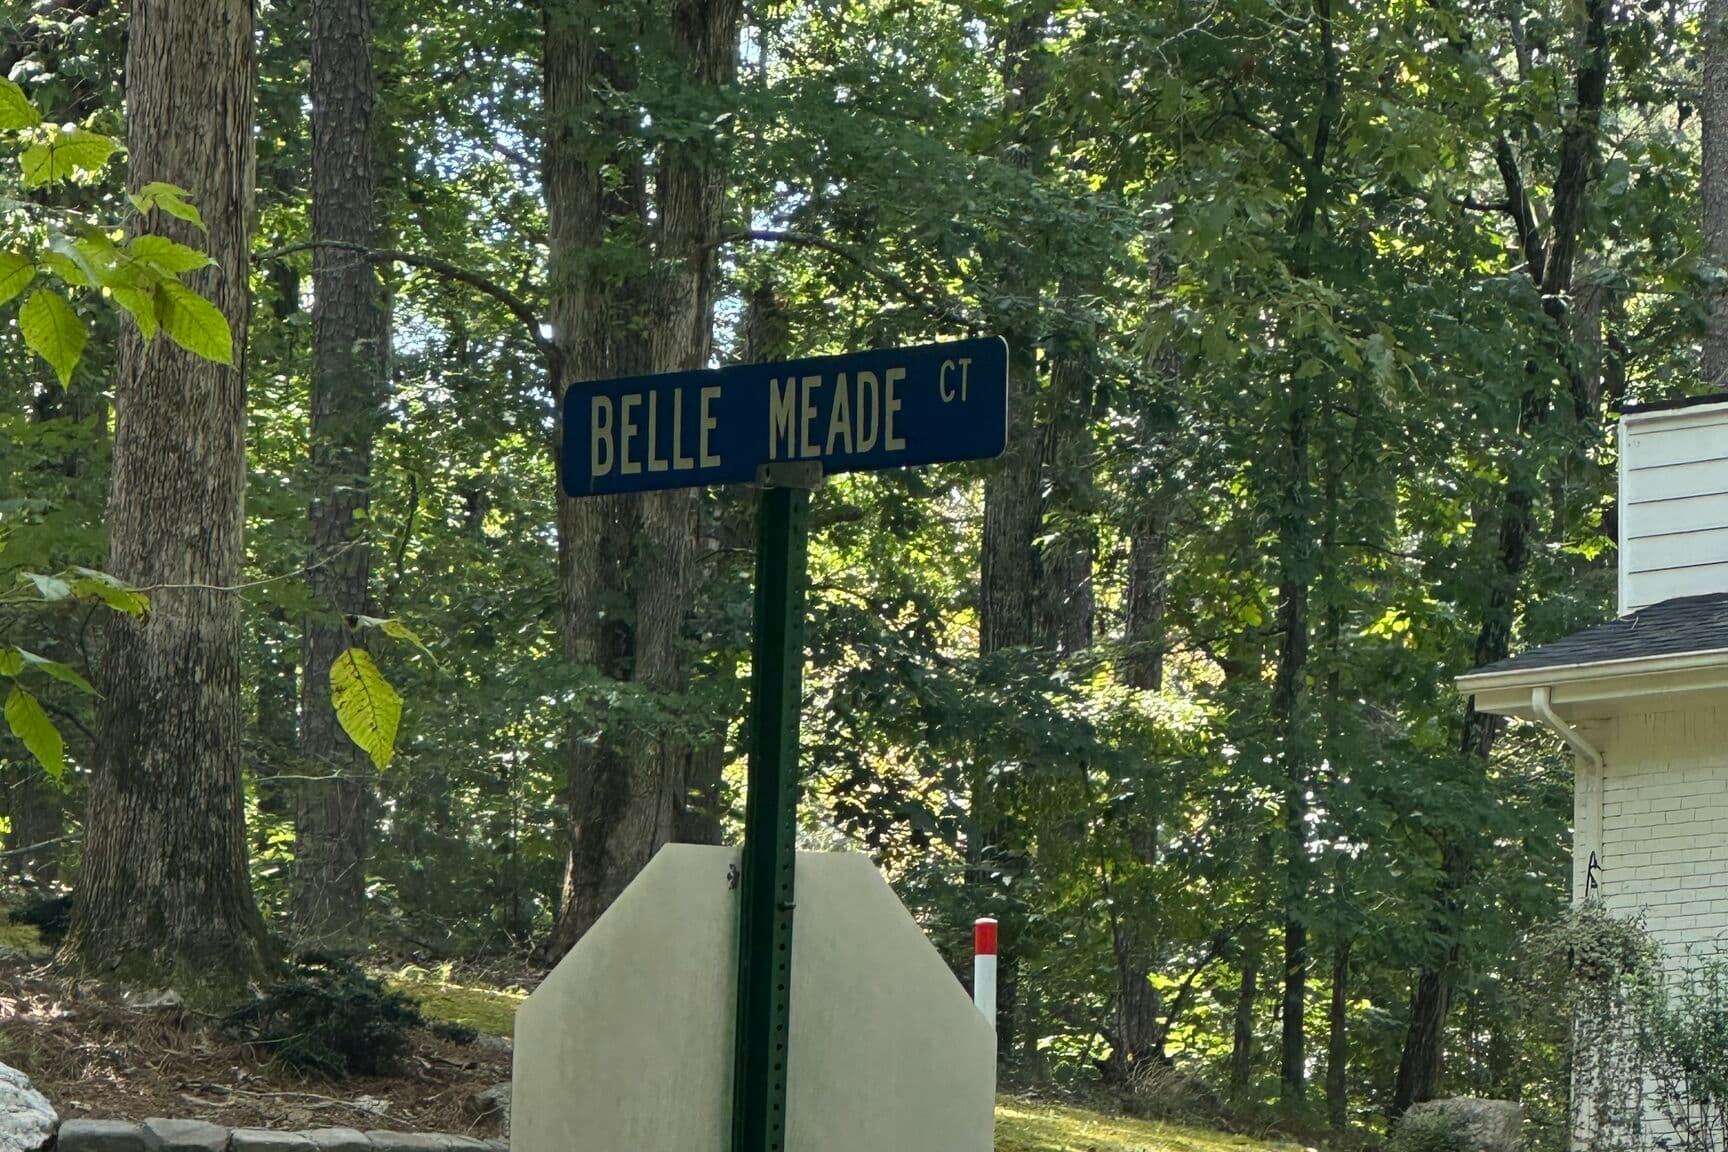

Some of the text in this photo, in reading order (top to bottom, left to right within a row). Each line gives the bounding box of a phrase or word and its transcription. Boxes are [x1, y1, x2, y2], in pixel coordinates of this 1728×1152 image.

[590, 357, 973, 477] BELLE MEADE CT
